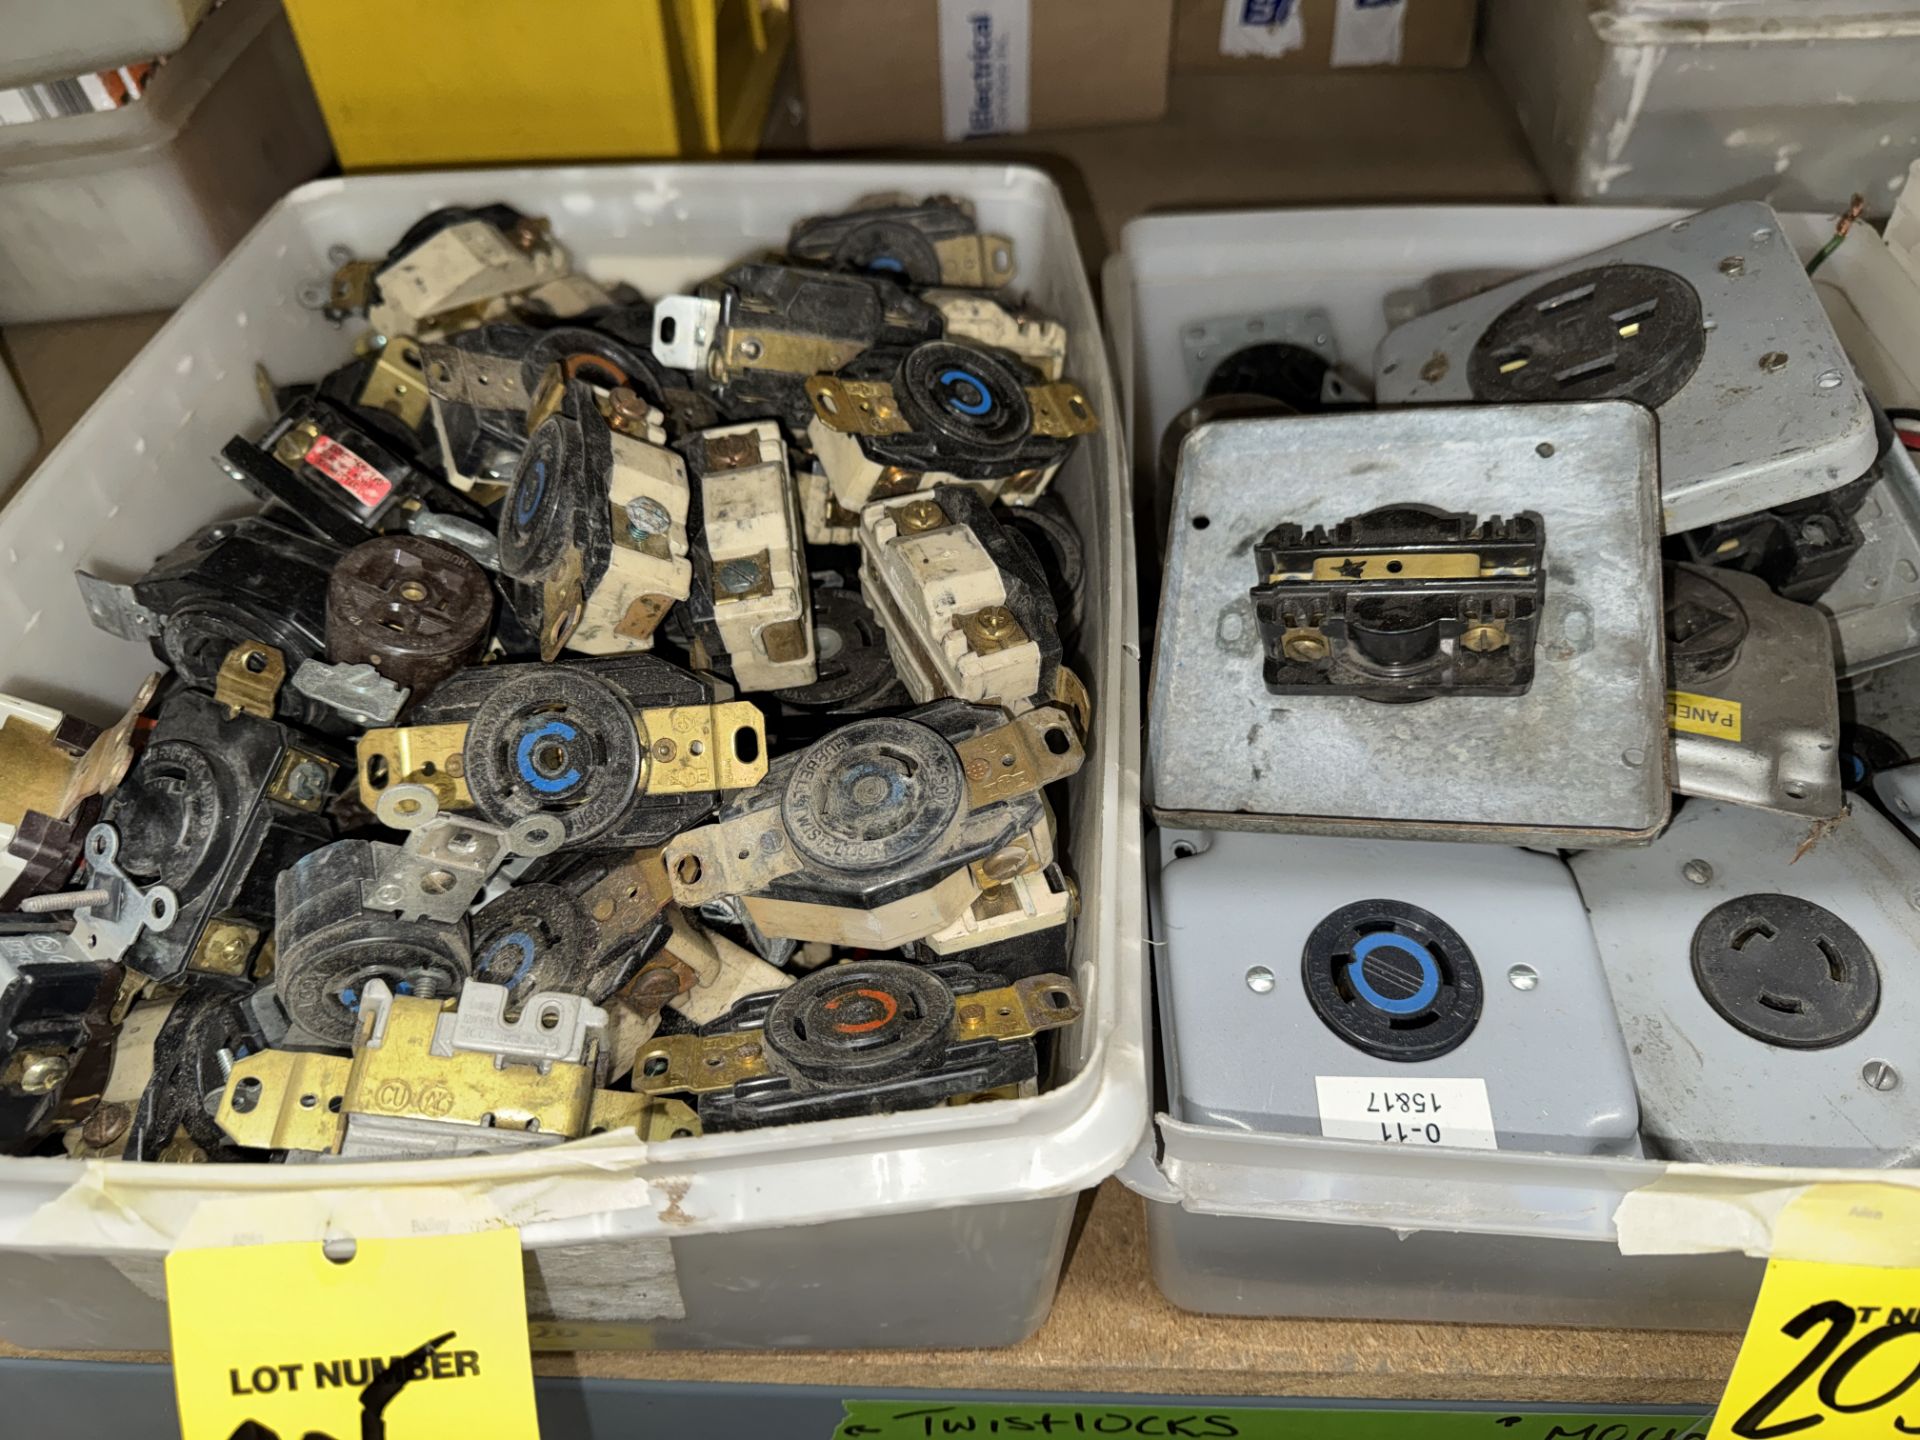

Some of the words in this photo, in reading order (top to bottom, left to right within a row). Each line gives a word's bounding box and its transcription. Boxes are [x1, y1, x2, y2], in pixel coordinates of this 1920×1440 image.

[1667, 702, 1733, 728] PANEL
[793, 735, 850, 798] HUBBELL
[1367, 1092, 1442, 1114] 15&17
[1380, 1121, 1441, 1144] 0-11
[229, 1363, 303, 1396] LOT
[1731, 1300, 1920, 1440] 20
